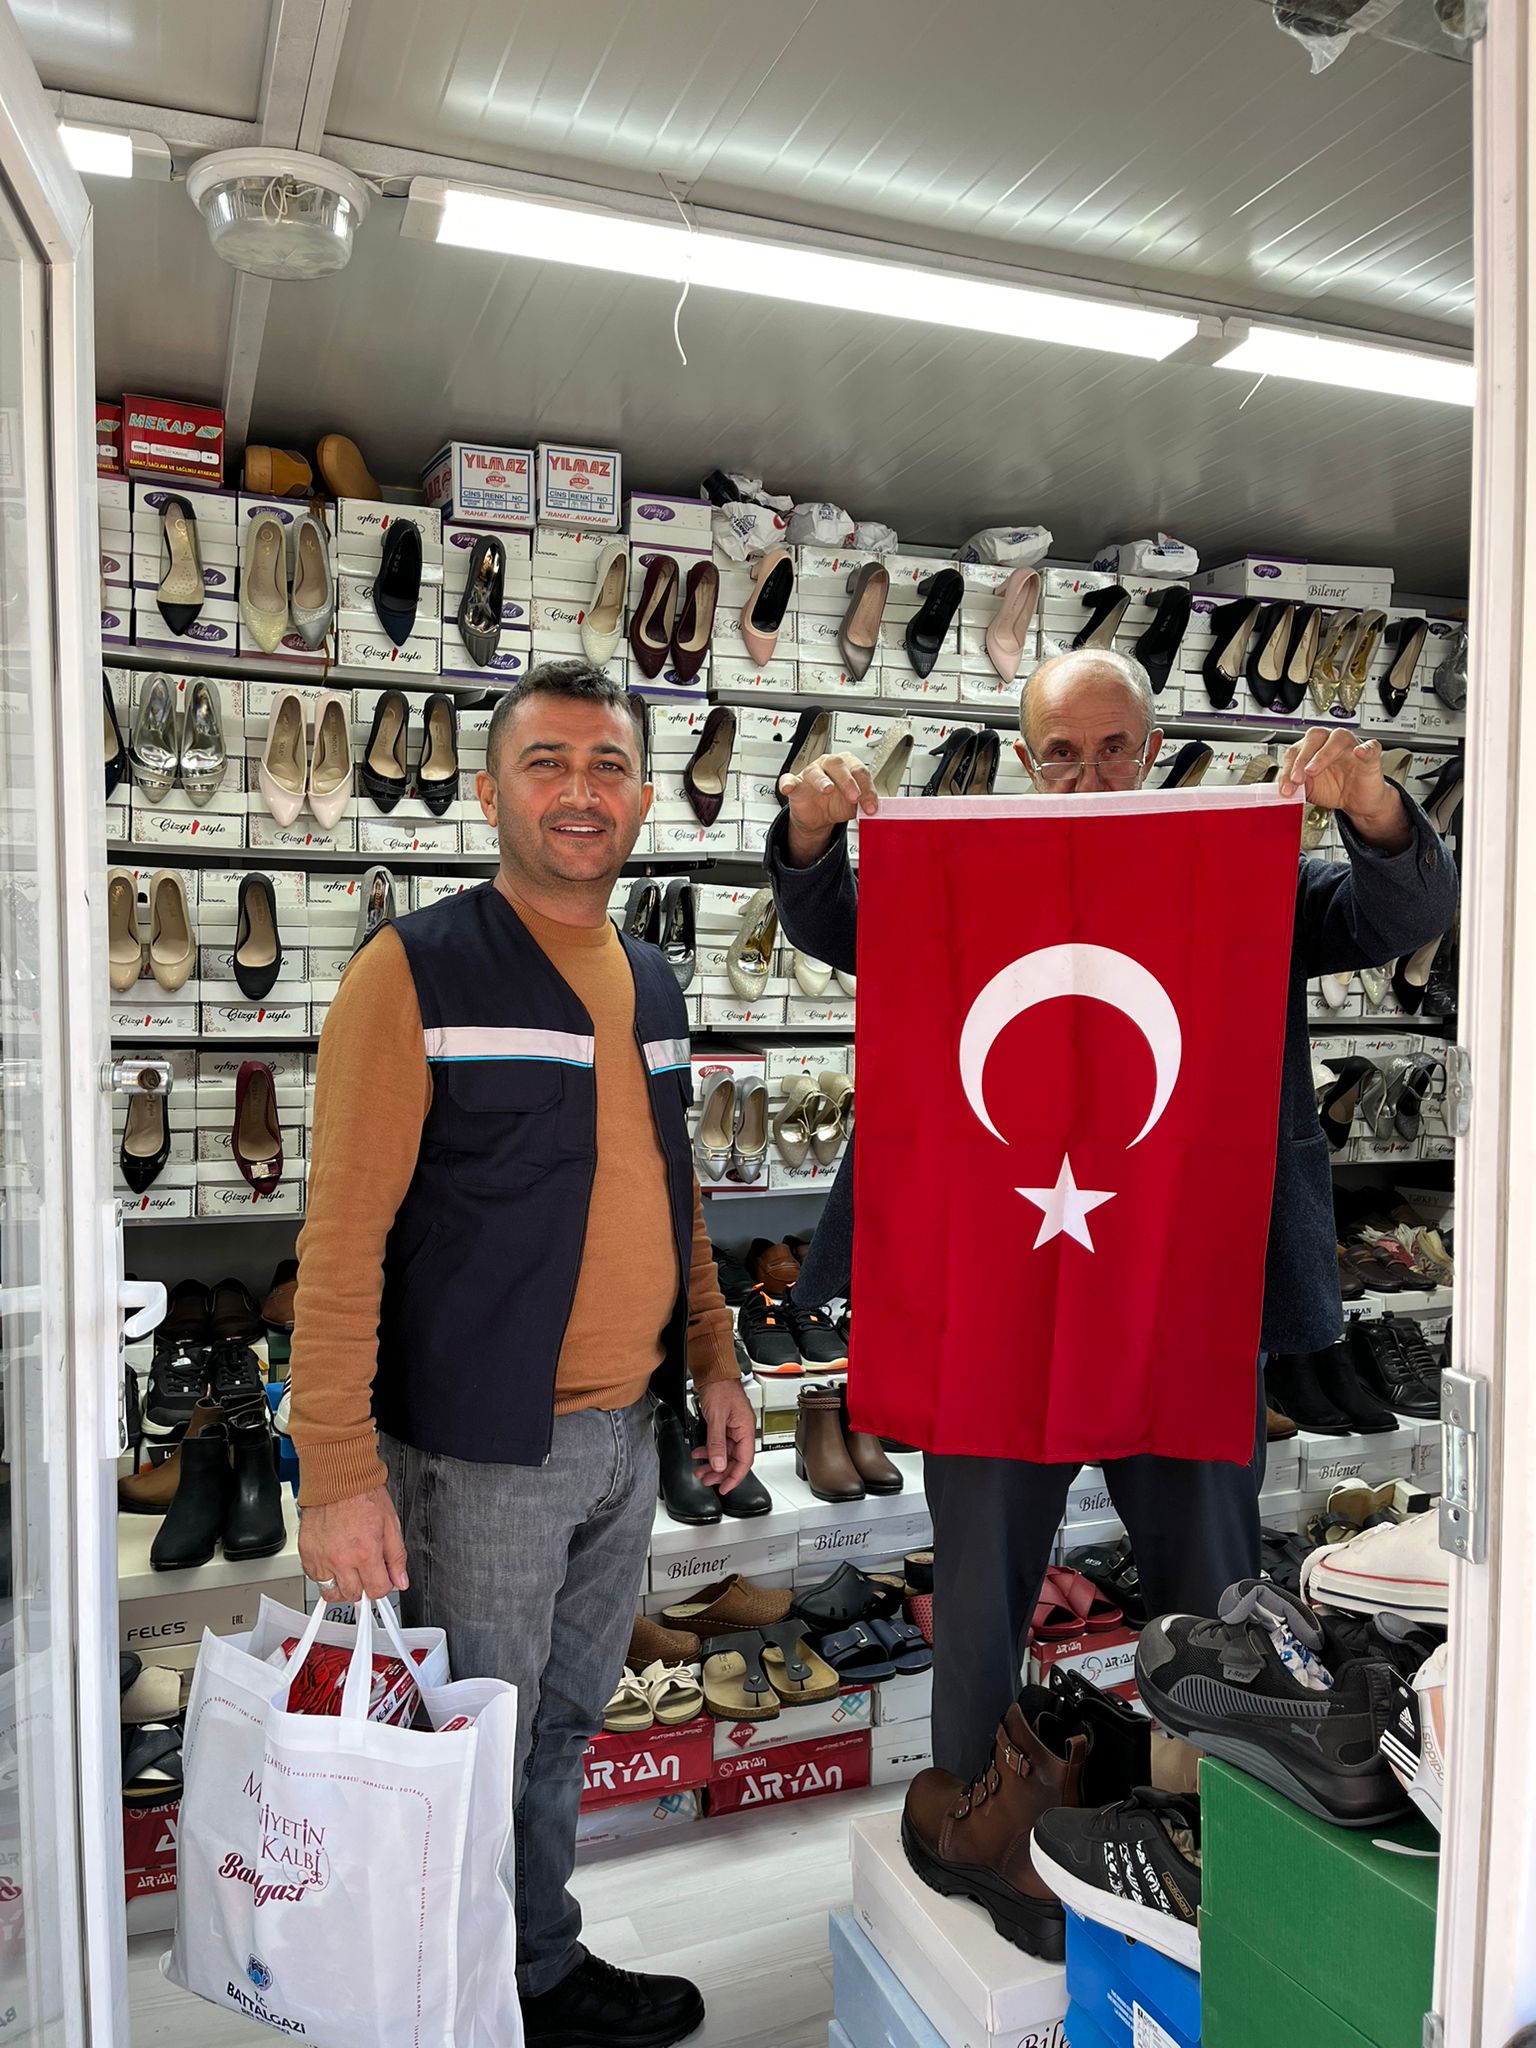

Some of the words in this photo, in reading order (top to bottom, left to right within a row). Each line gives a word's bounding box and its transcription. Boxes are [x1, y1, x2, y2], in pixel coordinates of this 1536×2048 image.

[129, 413, 195, 435] MEKAP
[464, 453, 527, 475] YILMAZ
[549, 456, 611, 477] YILMAZ
[570, 493, 590, 501] RENK
[1308, 584, 1348, 598] Bilener
[545, 607, 578, 624] Çizgi
[355, 644, 391, 662] Çizgi
[399, 651, 422, 663] style
[151, 817, 192, 834] Çizgi
[200, 824, 226, 836] style
[667, 828, 699, 842] Çizgi
[706, 830, 726, 842] style
[275, 830, 305, 844] Çizgi
[312, 834, 333, 845] style
[384, 836, 412, 850] Çizgi
[419, 840, 439, 850] style
[323, 880, 347, 892] style
[434, 882, 456, 895] style
[111, 1013, 144, 1027] Çizgi
[152, 1016, 173, 1027] style
[219, 1006, 257, 1023] Çizgi
[266, 1009, 291, 1021] style
[214, 1061, 239, 1073] style
[150, 1199, 176, 1211] style
[214, 1190, 251, 1204] Çizgi
[1319, 1461, 1362, 1479] Bilener
[1080, 1492, 1114, 1512] Bilen
[814, 1529, 869, 1551] Bilener
[667, 1556, 728, 1580] Bilener
[127, 1621, 186, 1641] FELES
[1165, 1874, 1192, 1915] adidas
